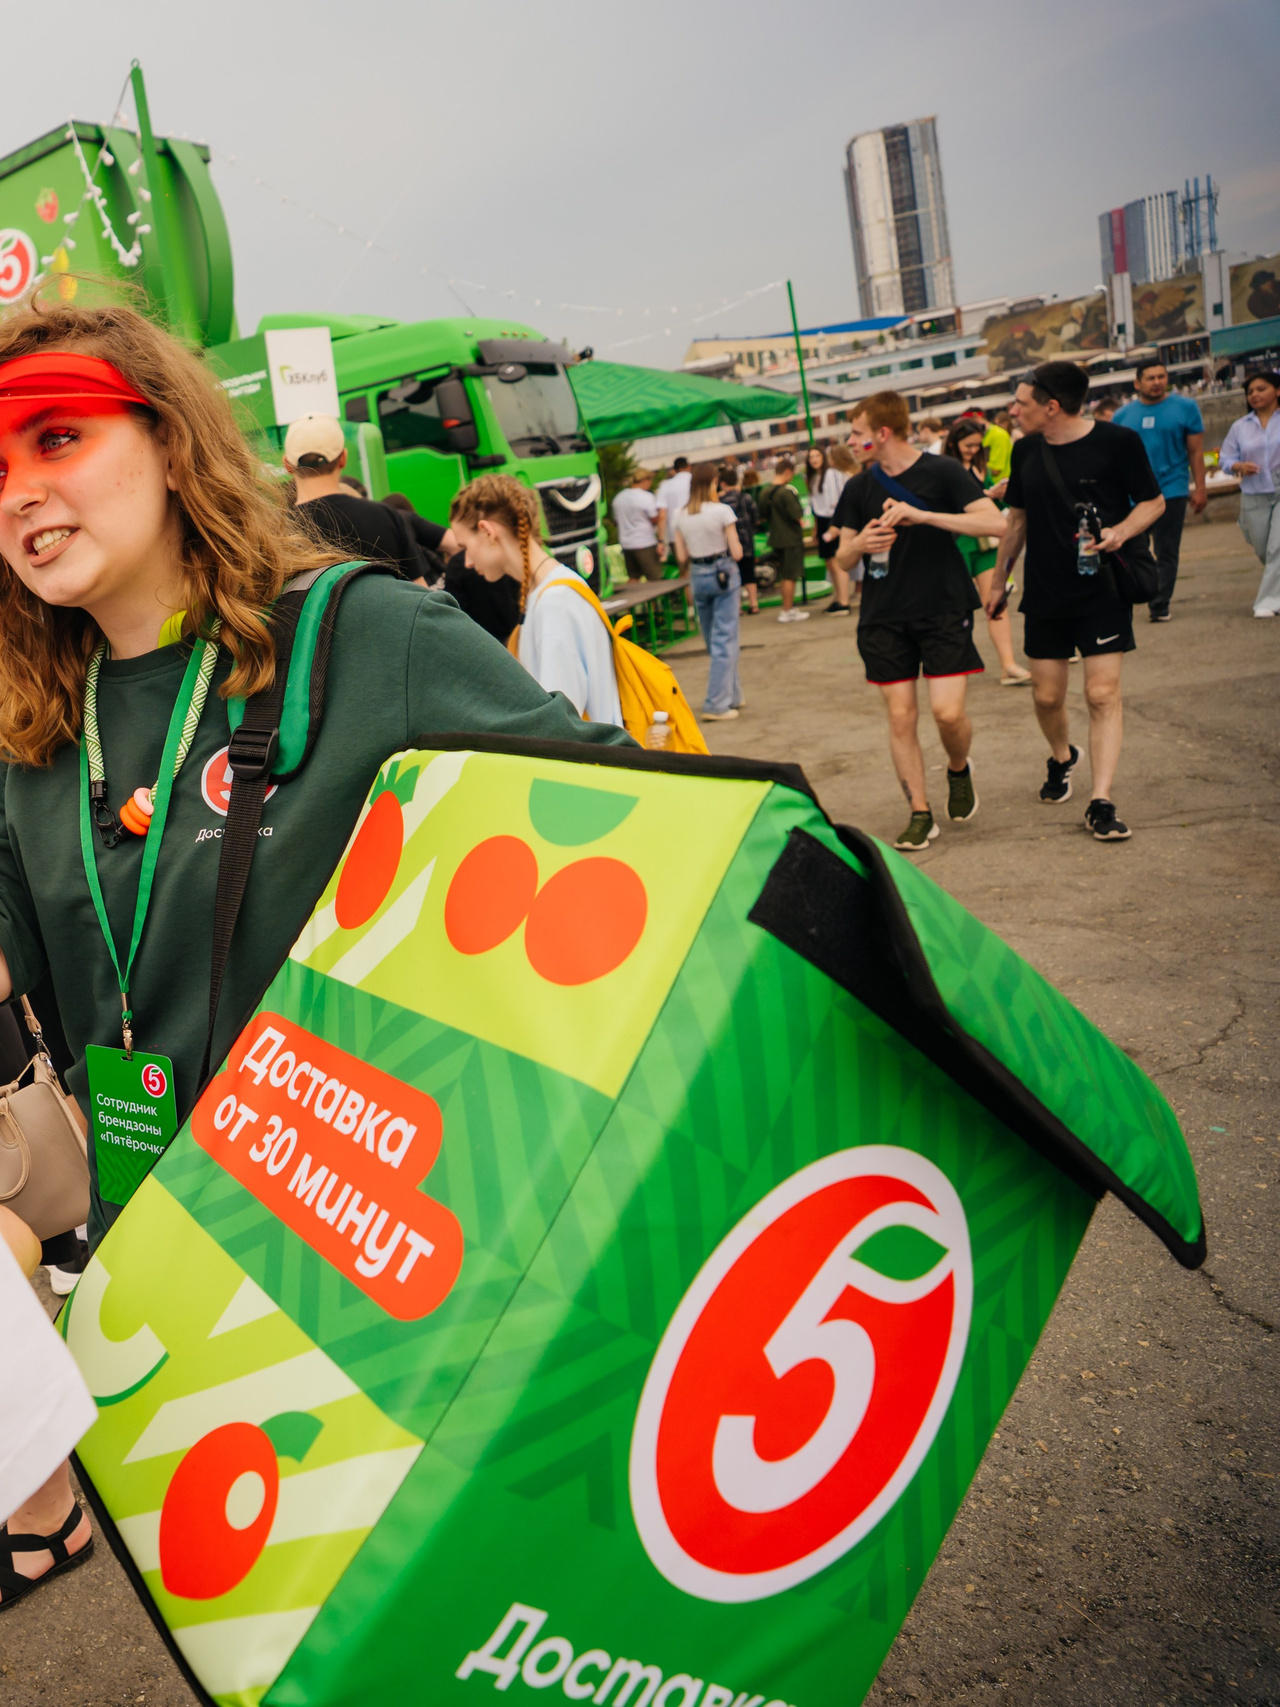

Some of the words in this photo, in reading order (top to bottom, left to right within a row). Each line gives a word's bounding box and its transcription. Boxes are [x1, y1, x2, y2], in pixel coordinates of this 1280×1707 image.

[96, 1093, 158, 1117] Сотрудник
[98, 1111, 162, 1136] брендзоны
[238, 1026, 418, 1169] Доставка
[213, 1094, 259, 1142] от
[248, 1115, 298, 1176] 30
[286, 1152, 436, 1284] минут
